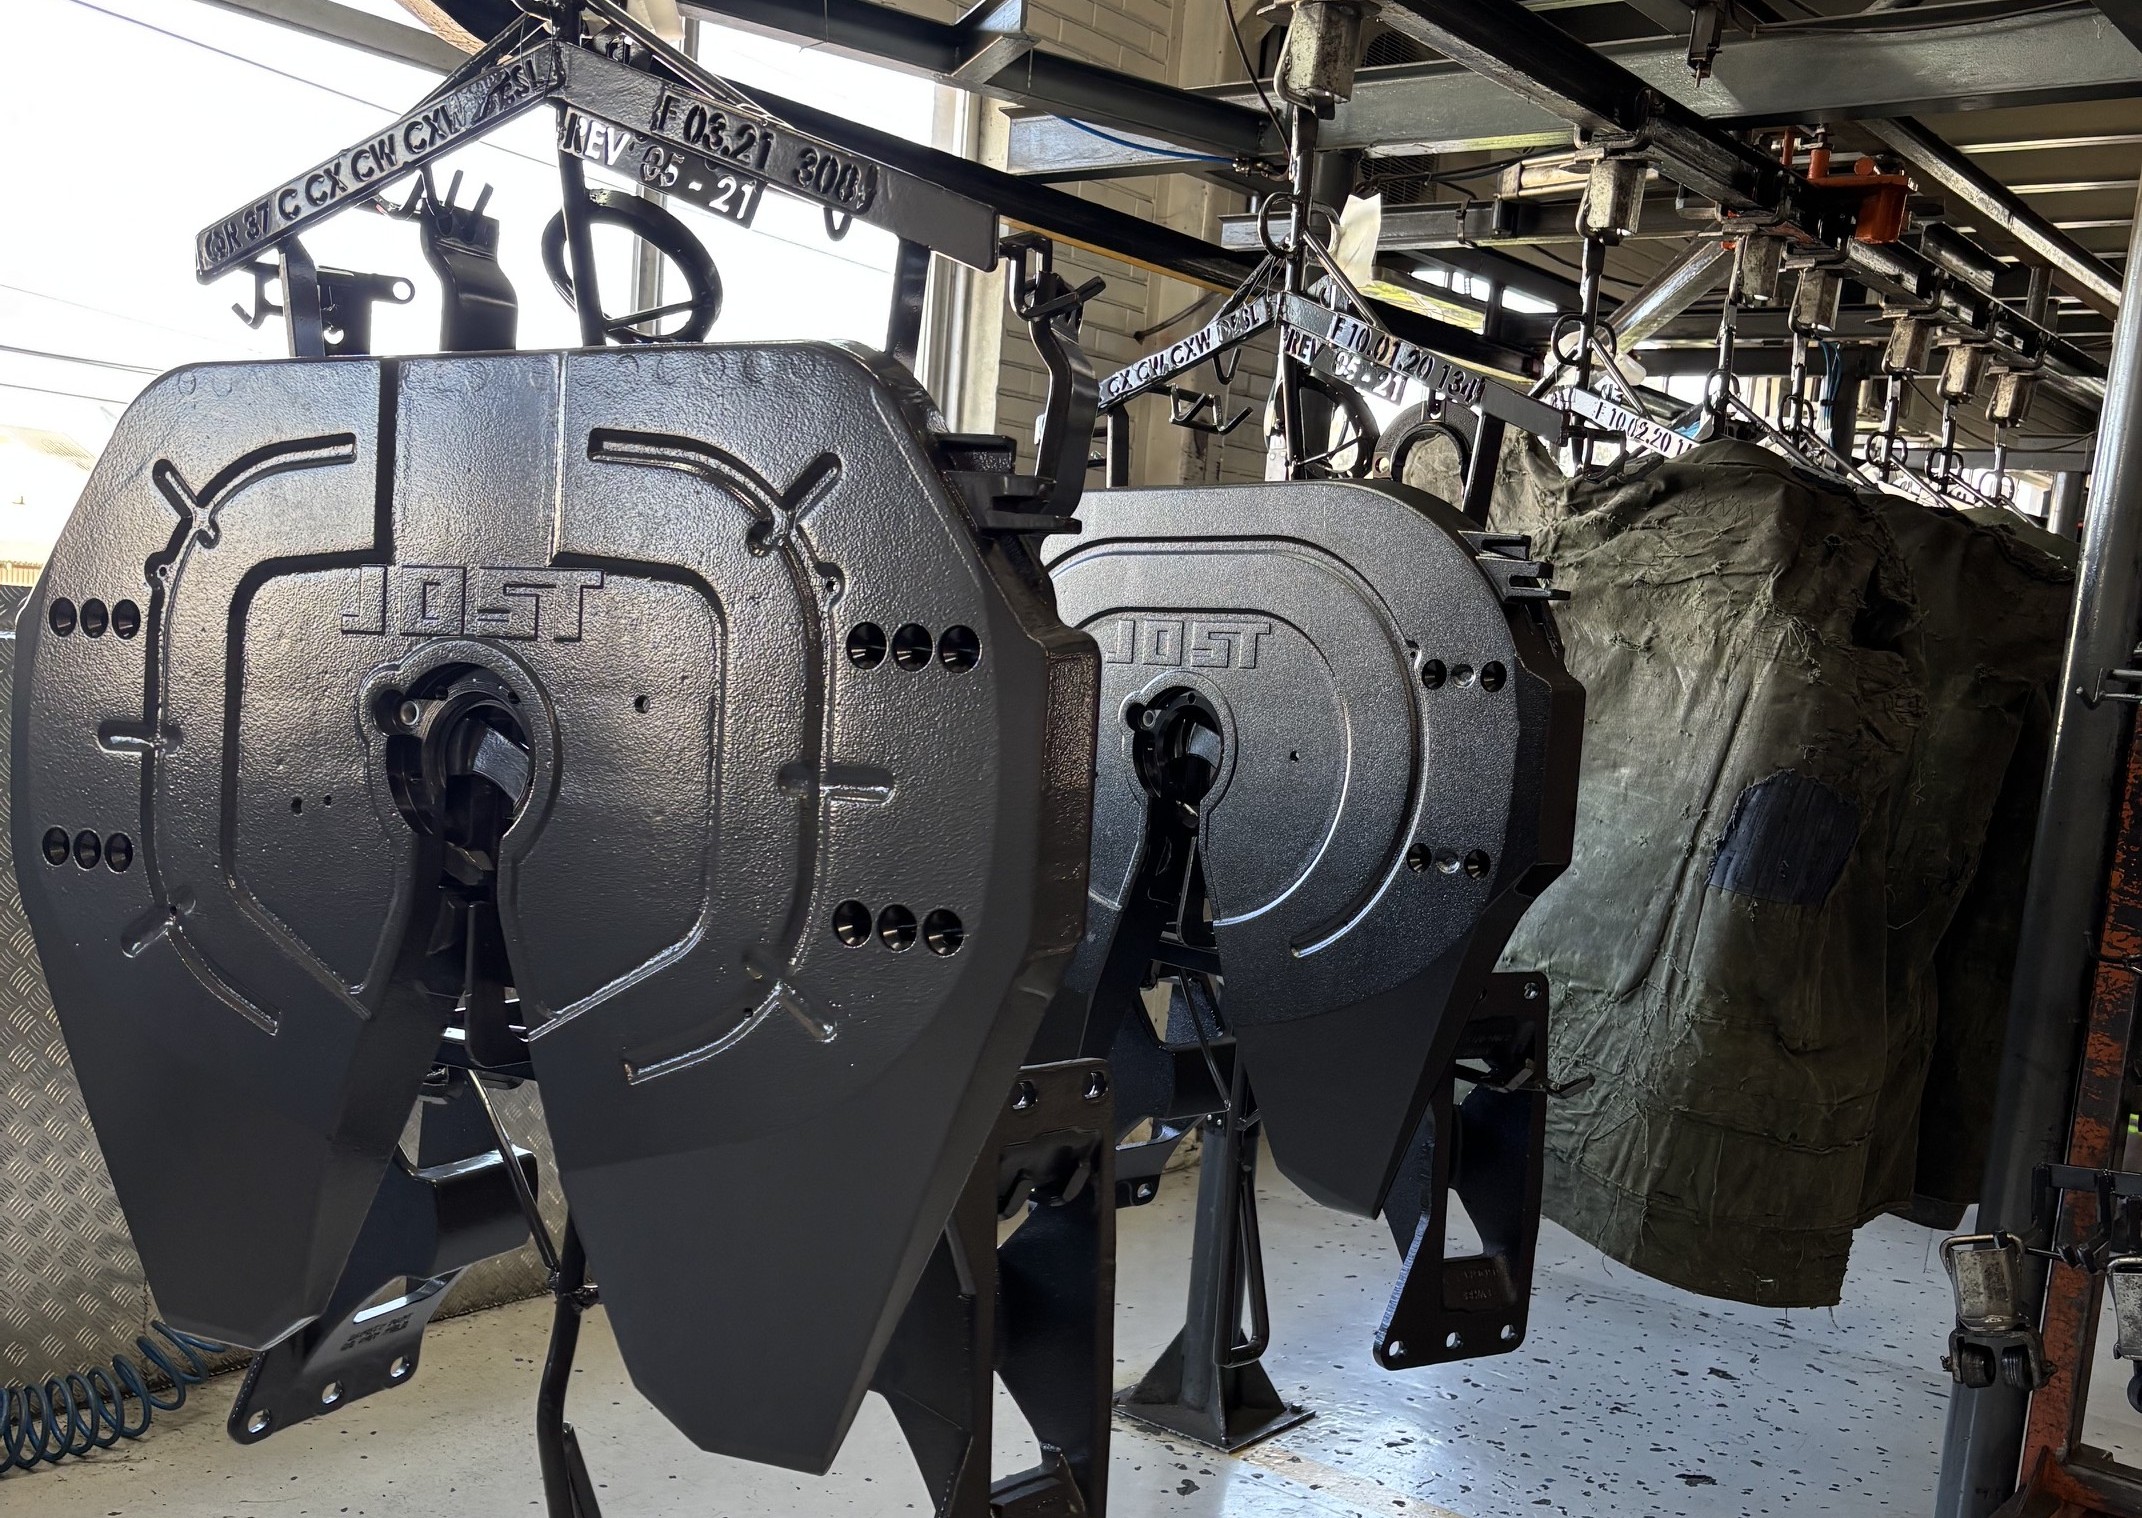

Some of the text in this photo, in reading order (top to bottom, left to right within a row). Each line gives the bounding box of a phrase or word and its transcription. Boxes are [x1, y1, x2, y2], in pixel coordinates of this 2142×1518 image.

[278, 188, 301, 221] C
[305, 162, 348, 206] CX
[351, 134, 397, 183] CW
[563, 112, 630, 166] REV
[709, 176, 757, 220] 21
[1107, 369, 1133, 397] CX
[1171, 328, 1211, 366] CXW
[1285, 328, 1326, 363] REV
[1373, 371, 1403, 401] 21
[1332, 316, 1347, 341] F
[341, 563, 604, 642] JOST
[1106, 619, 1271, 669] JOST
